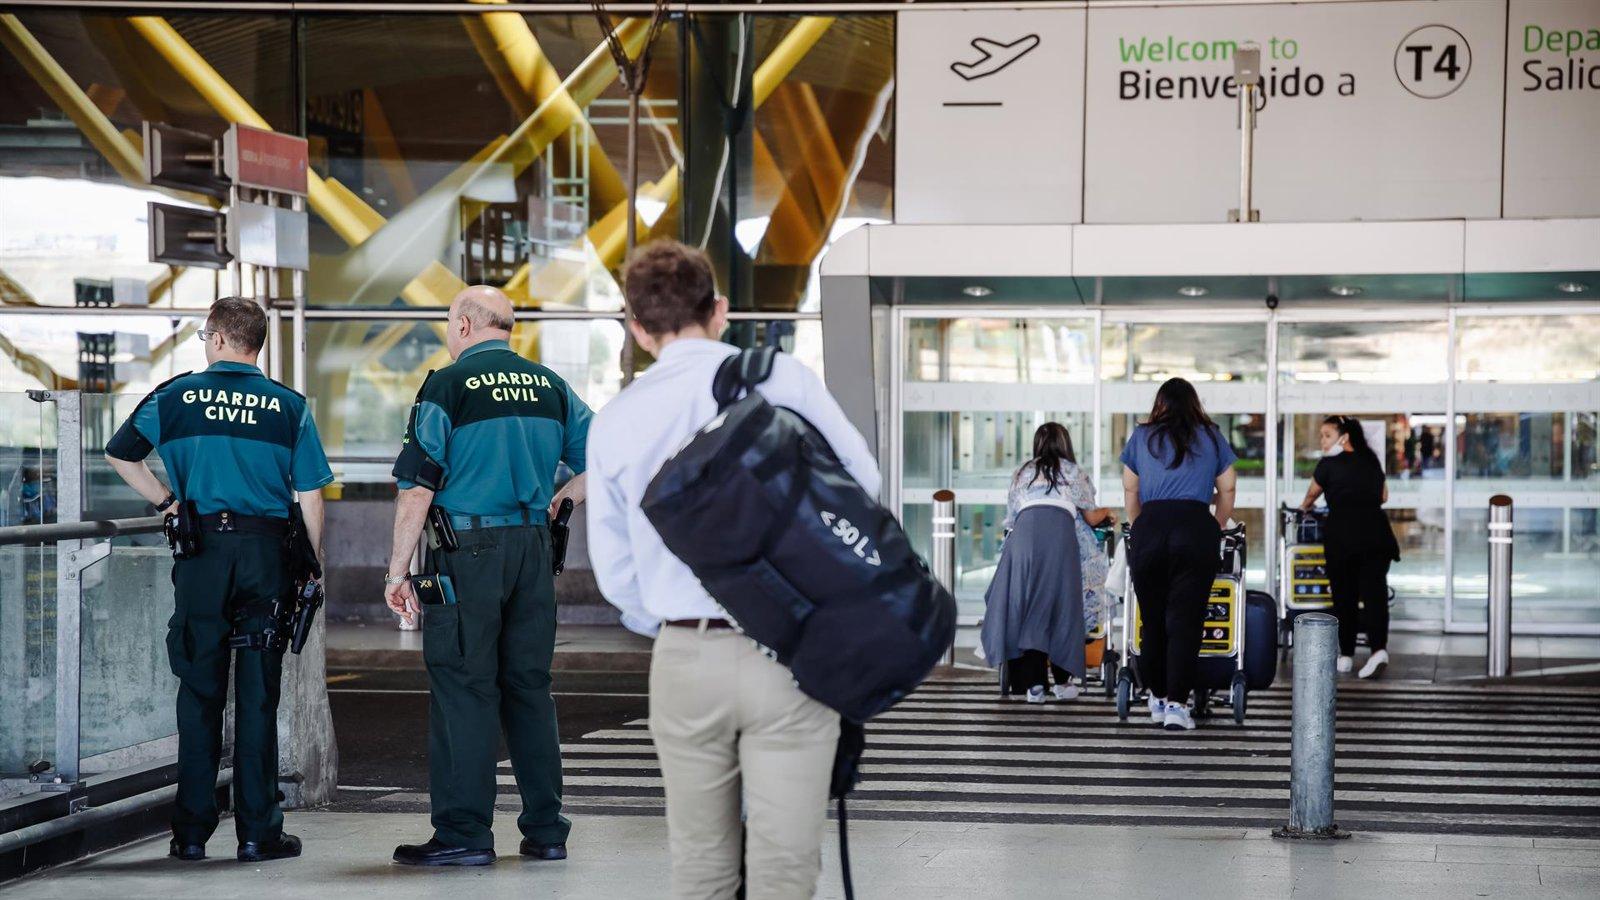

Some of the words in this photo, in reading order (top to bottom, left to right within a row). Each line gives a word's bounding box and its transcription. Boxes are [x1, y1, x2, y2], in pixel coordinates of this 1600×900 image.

[1118, 36, 1248, 62] Welcom
[1268, 36, 1298, 60] to
[1405, 45, 1461, 82] T4
[1338, 73, 1355, 96] a
[465, 372, 551, 390] GUARDIA
[182, 389, 281, 412] GUARDIA
[492, 387, 538, 402] CIVIL
[204, 405, 258, 425] CIVIL
